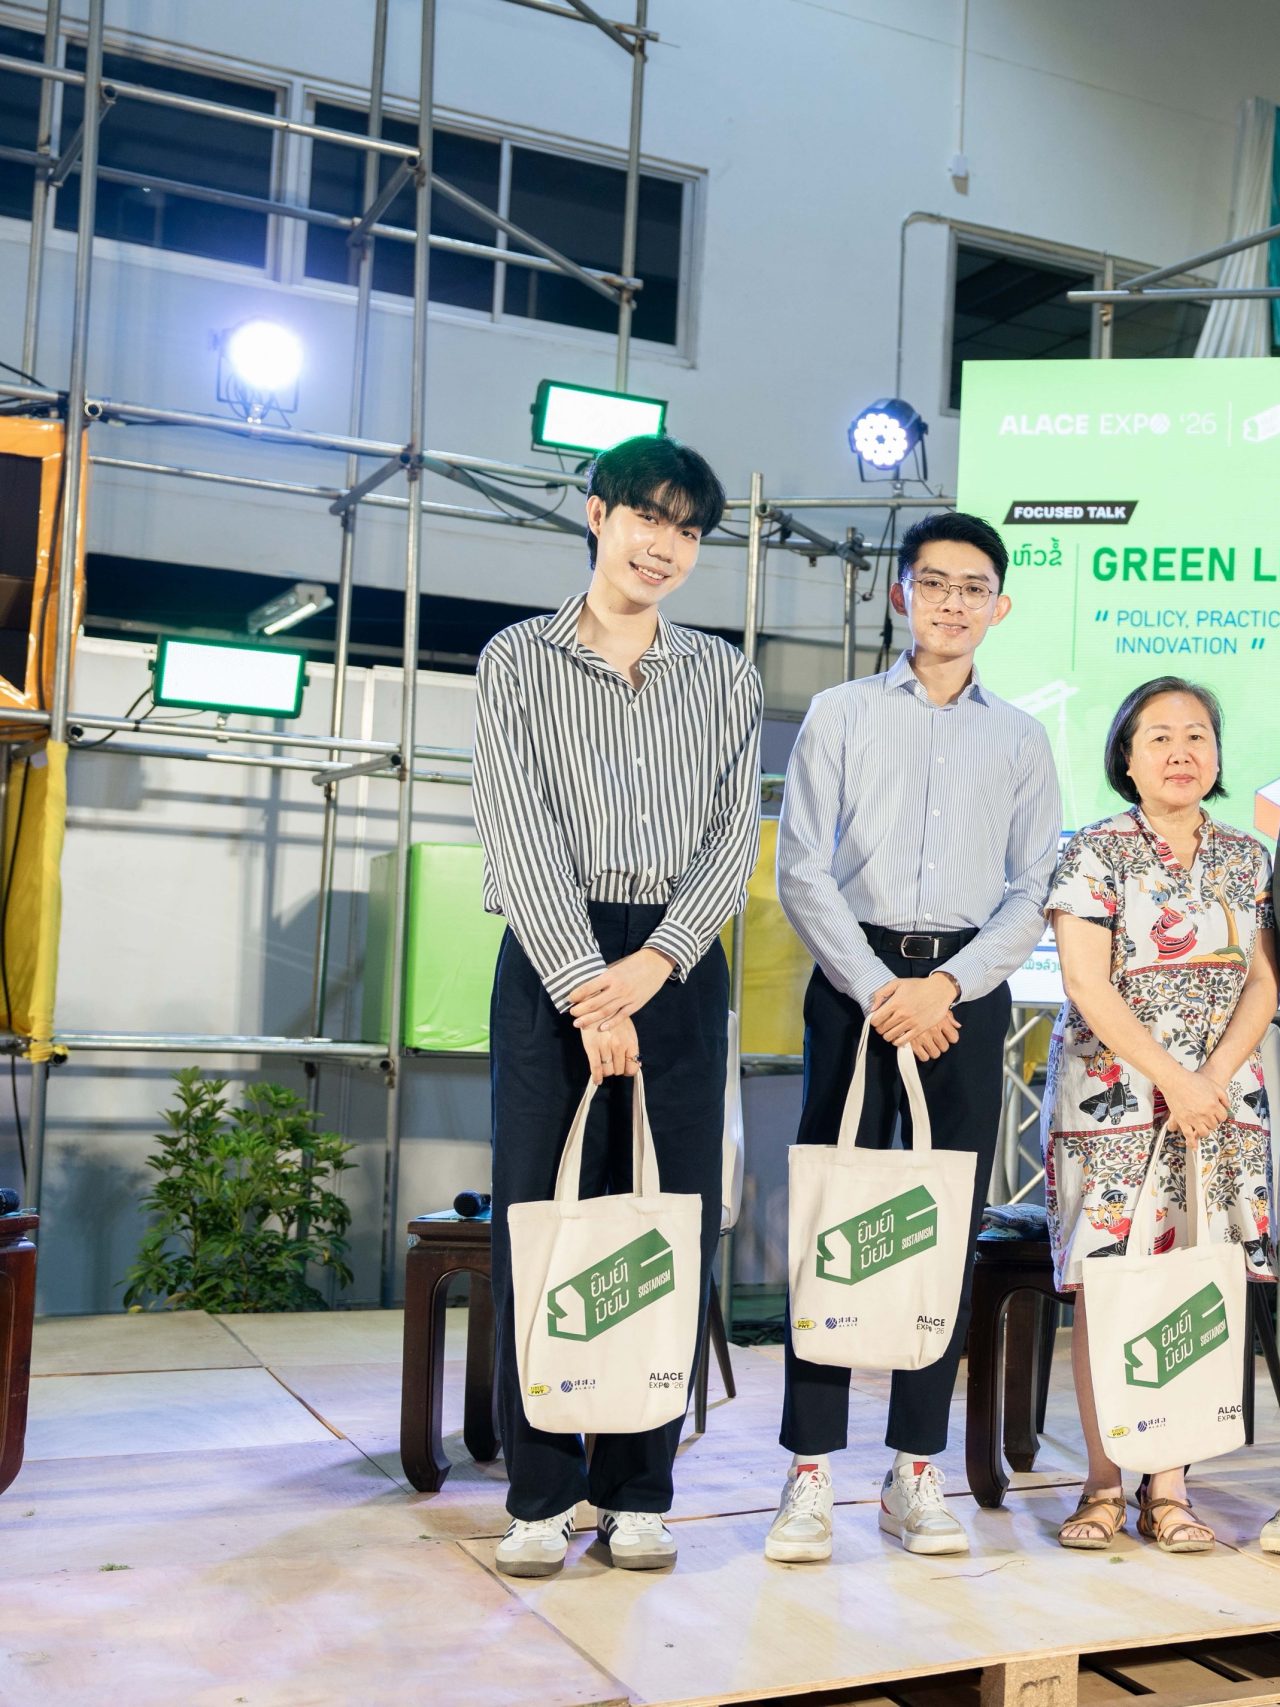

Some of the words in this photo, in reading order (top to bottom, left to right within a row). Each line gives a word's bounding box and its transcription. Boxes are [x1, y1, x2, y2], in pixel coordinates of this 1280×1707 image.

[1000, 414, 1090, 435] ALACE
[1013, 506, 1084, 519] FOCUSED
[1086, 506, 1127, 519] TALK
[1092, 546, 1235, 582] GREEN
[1116, 610, 1188, 630] POLICY,
[1115, 636, 1238, 655] INNOVATION
[901, 1225, 934, 1250] SUSTAINISM
[638, 1269, 671, 1299] SUSTAINISM
[917, 1315, 946, 1327] ALACE
[649, 1372, 684, 1381] ALACE
[1218, 1405, 1242, 1415] ALAC
